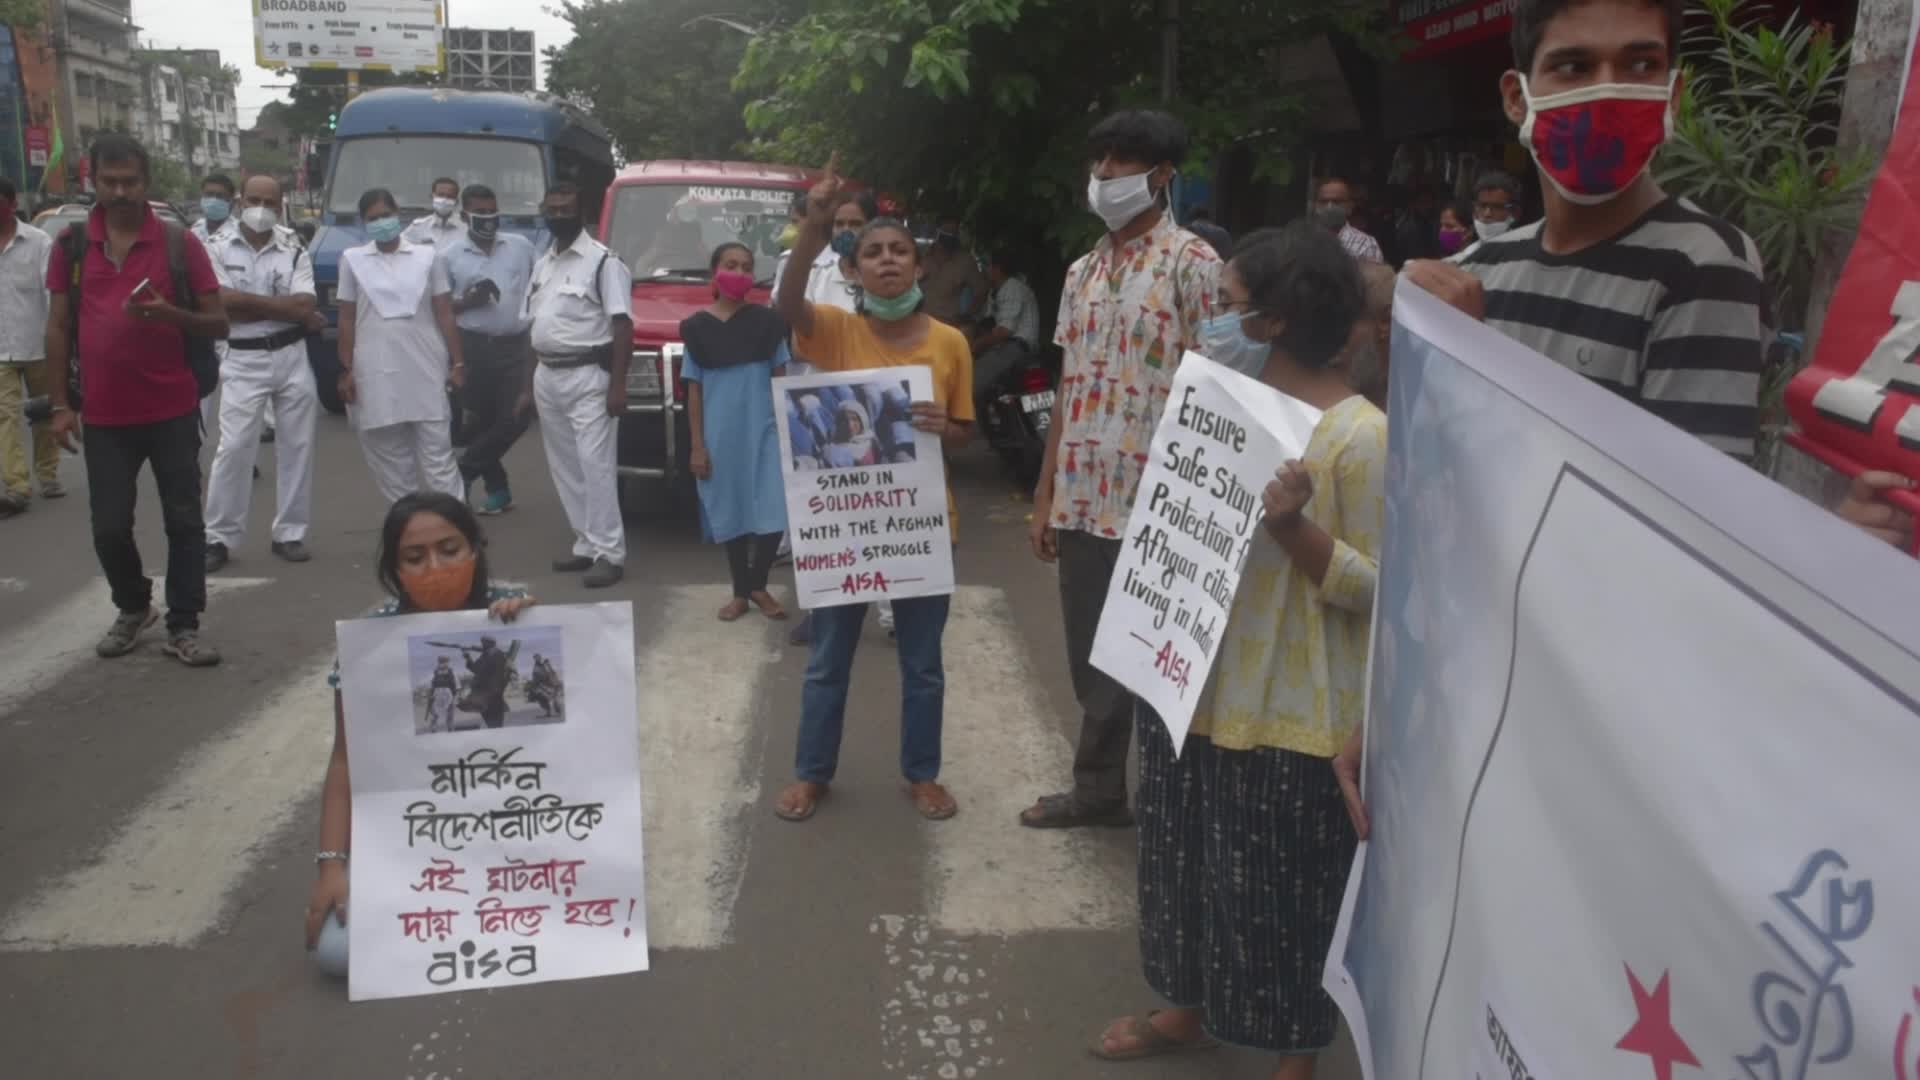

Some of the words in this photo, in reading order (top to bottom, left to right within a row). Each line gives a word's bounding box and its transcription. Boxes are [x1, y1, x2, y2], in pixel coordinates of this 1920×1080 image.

[261, 0, 347, 13] BROADBAND
[1484, 0, 1518, 23] MOTO
[688, 186, 747, 201] KOLKATA
[751, 190, 795, 204] POLICE
[1177, 385, 1247, 453] Ensure
[808, 487, 918, 515] SOLIDARITY
[817, 471, 870, 490] STAND
[876, 470, 894, 485] IN
[1163, 441, 1209, 487] Safe
[1210, 466, 1255, 536] Stay
[799, 523, 840, 541] WITH
[848, 519, 878, 537] THE
[885, 514, 944, 534] AFGHAN
[1149, 482, 1235, 562] Protection
[795, 547, 857, 572] WOMEN'S
[862, 540, 932, 562] STRUGGLE
[841, 571, 888, 595] AISA
[1123, 567, 1172, 630] living
[1174, 598, 1191, 631] in
[1154, 639, 1192, 698] AISA
[428, 746, 547, 798] মার্কিন
[403, 793, 605, 851] বিদেশনীতিকে
[410, 857, 469, 894] এই
[486, 856, 586, 897] ঘটনার
[397, 906, 460, 942] দায়
[474, 897, 551, 936] নিতে
[426, 940, 537, 986] aisa
[1486, 1001, 1537, 1080] আফ
